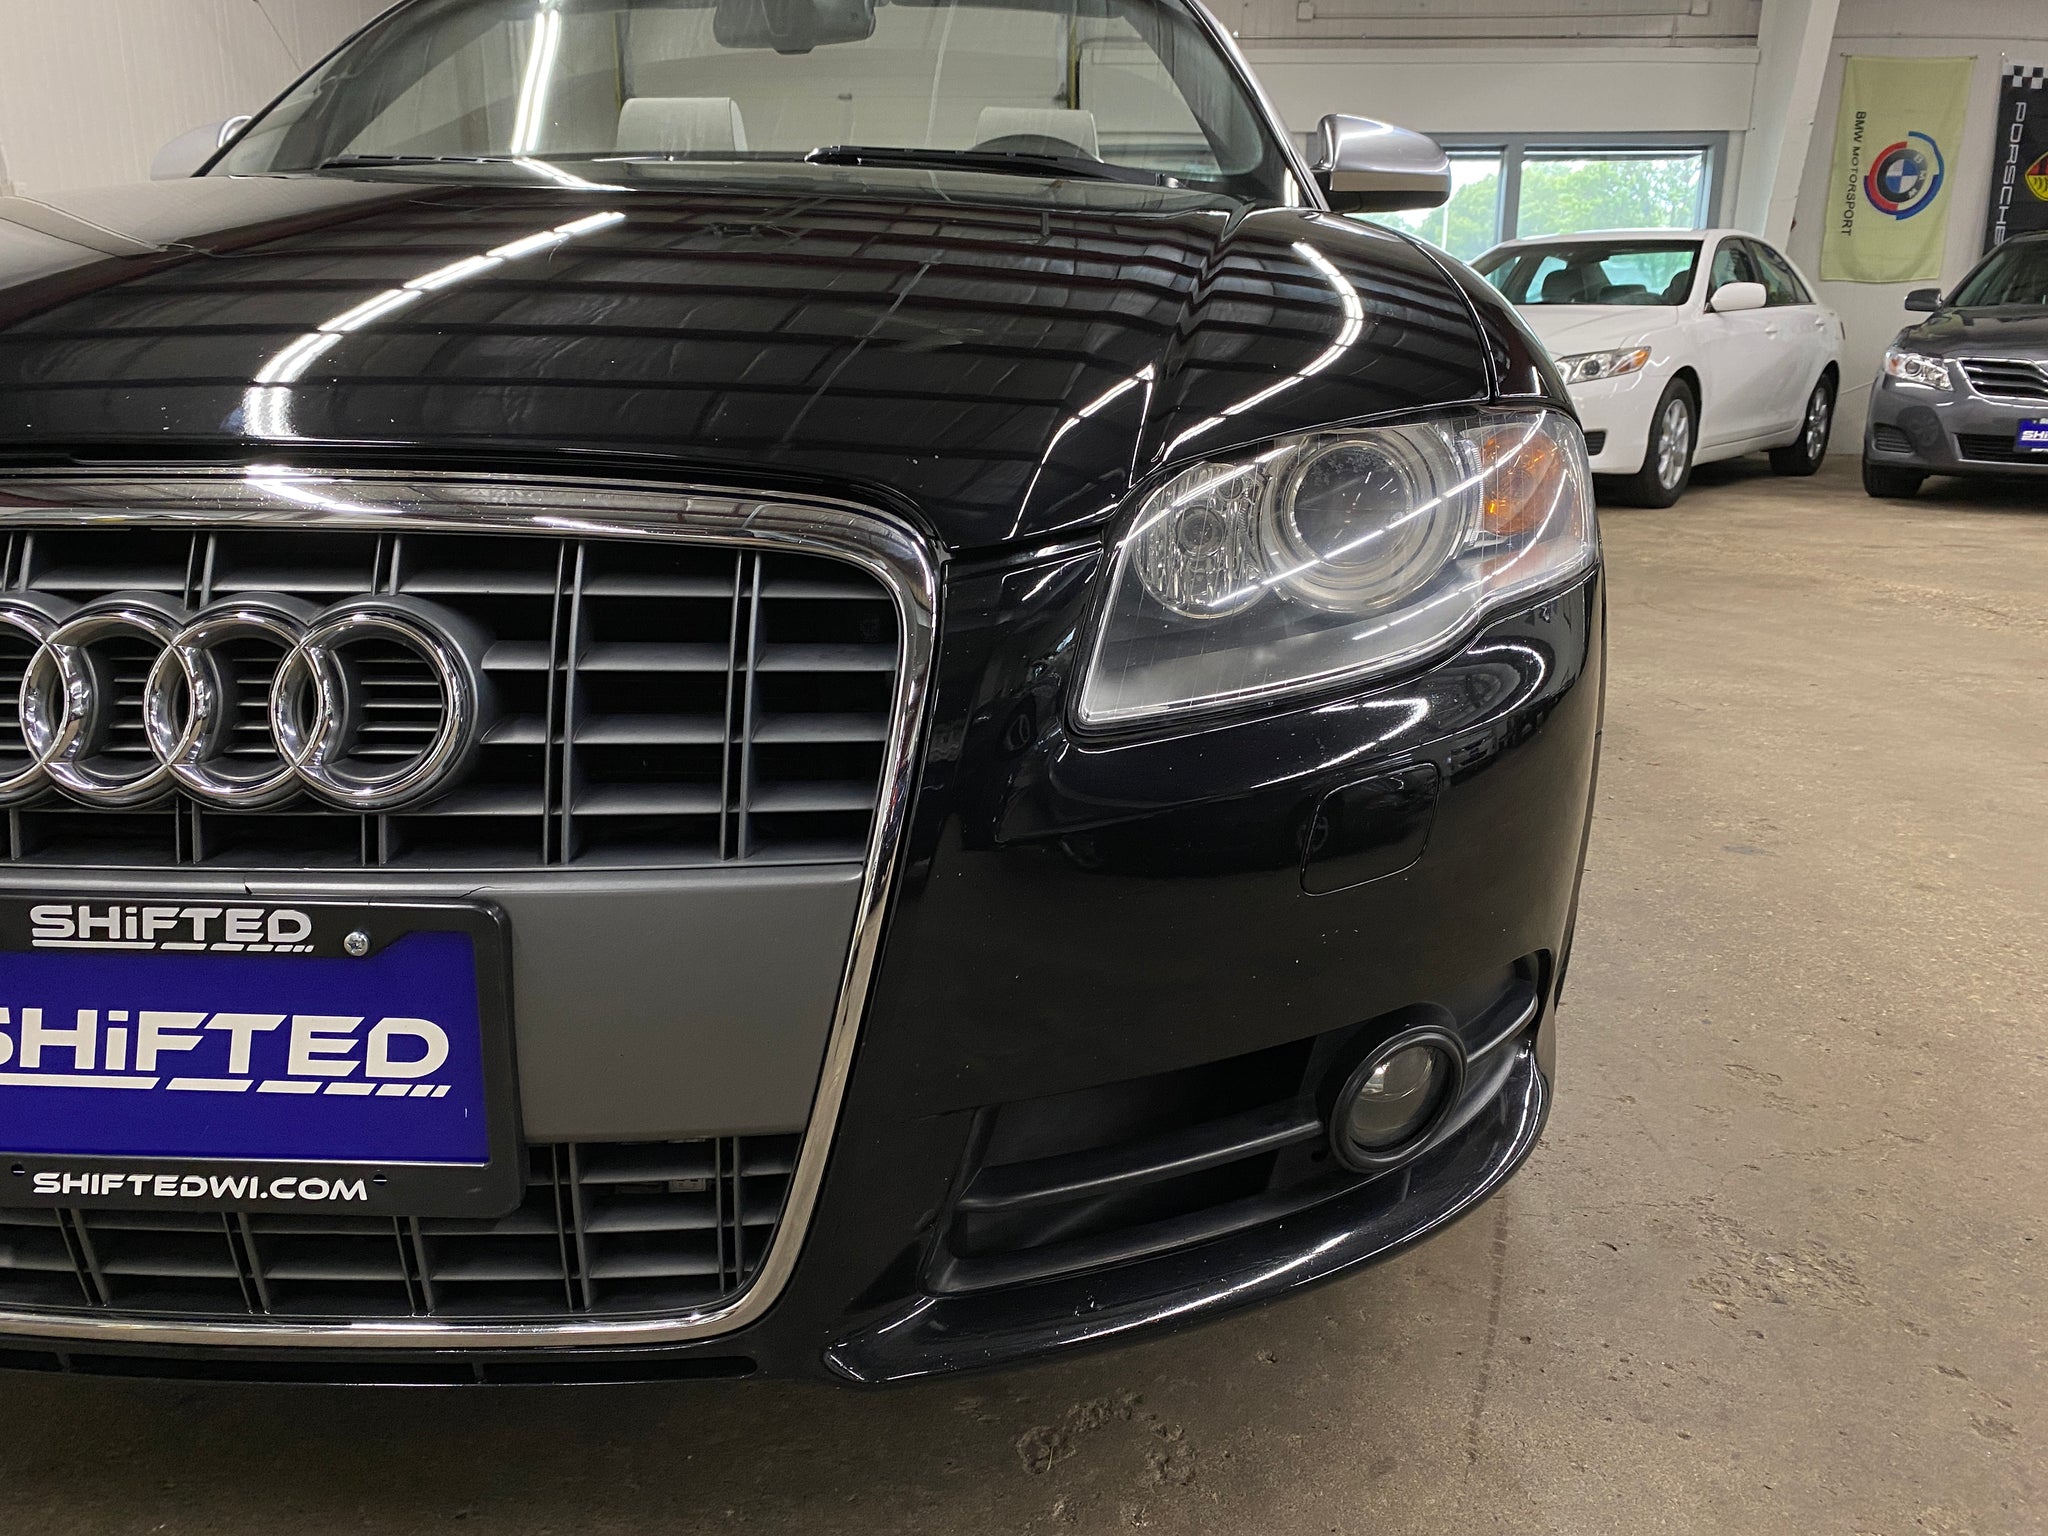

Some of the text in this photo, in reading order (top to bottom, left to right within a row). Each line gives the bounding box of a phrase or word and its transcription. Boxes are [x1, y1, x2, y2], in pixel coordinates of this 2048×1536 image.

[1841, 111, 1866, 236] BMW MOTORSPORT
[1994, 102, 2027, 245] PORSCHE
[0, 1007, 449, 1078] HiFTED
[33, 1172, 368, 1200] SHIFTEDWI.COM
